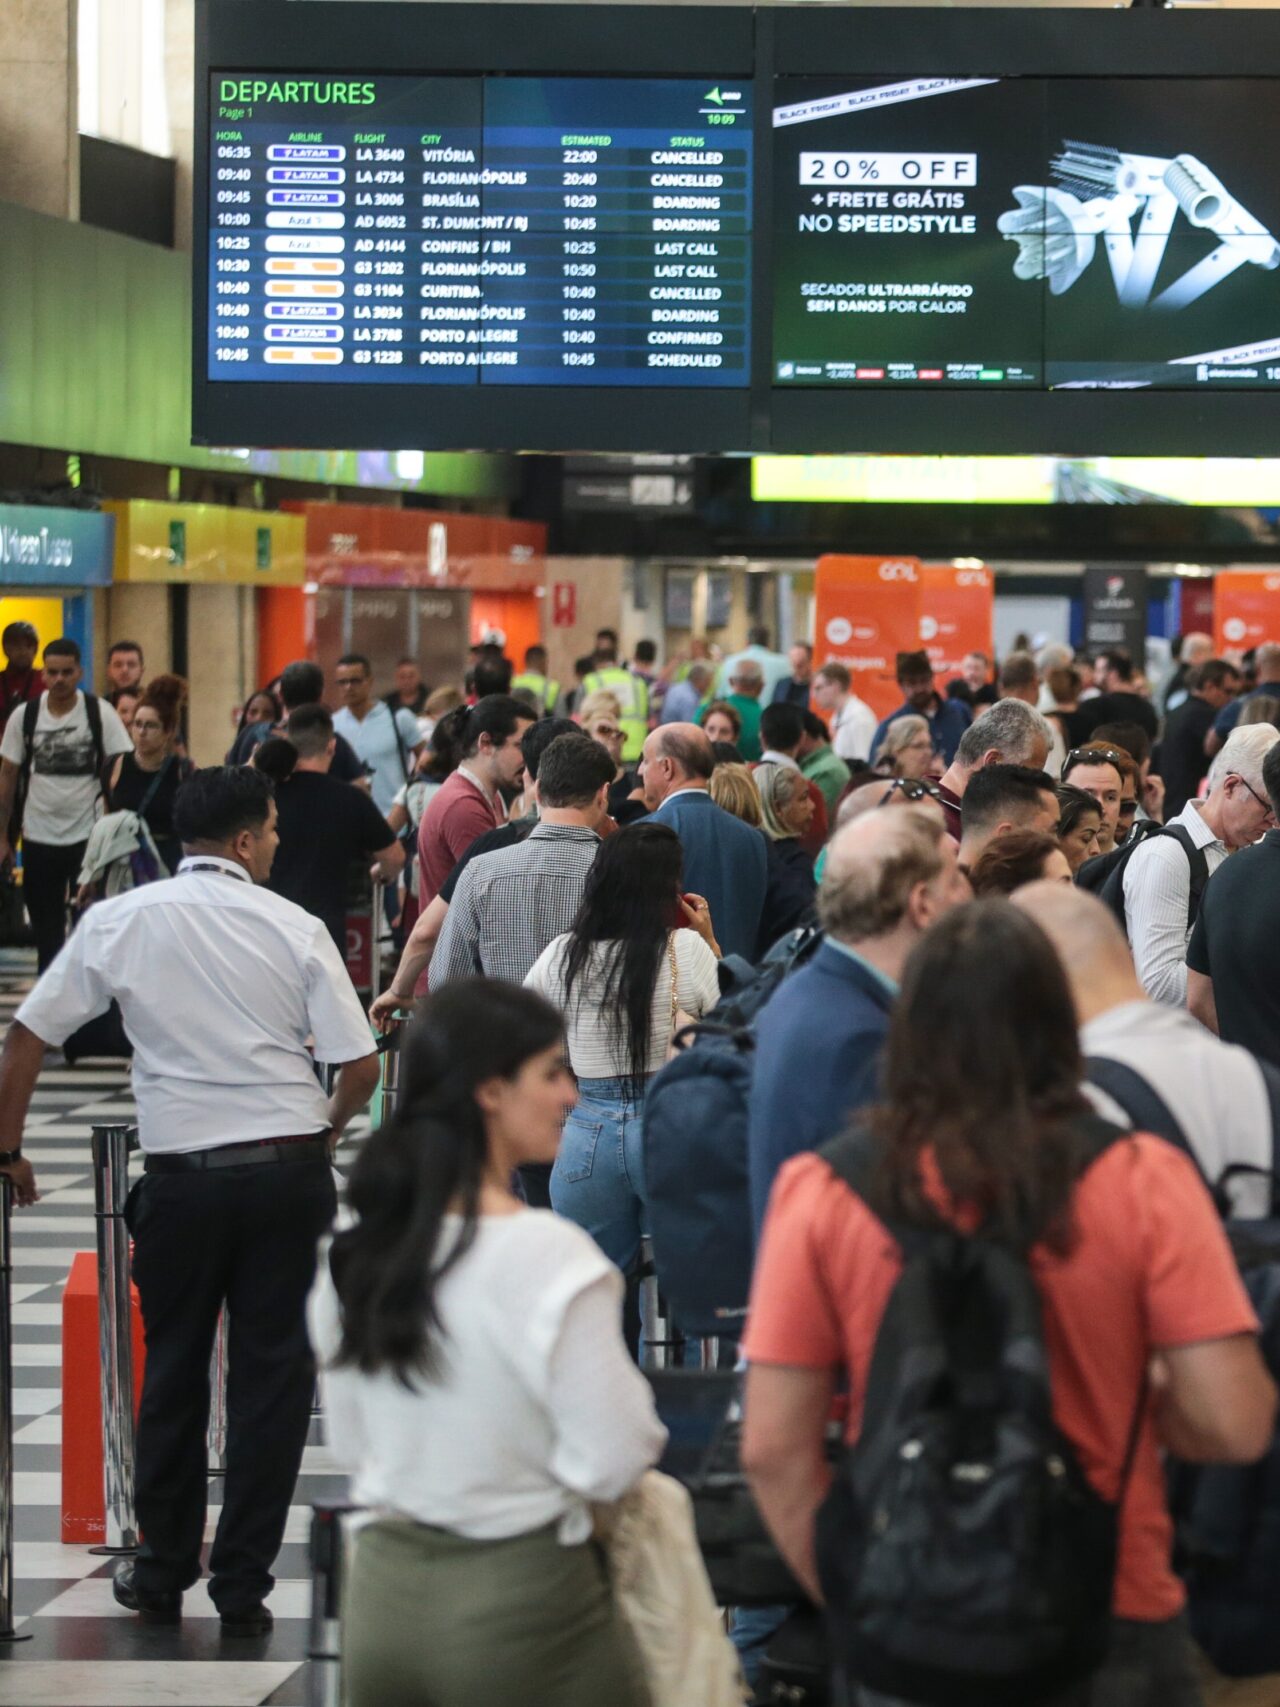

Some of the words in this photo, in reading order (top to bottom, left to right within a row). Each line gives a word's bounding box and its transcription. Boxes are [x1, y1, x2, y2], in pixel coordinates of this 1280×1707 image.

[221, 80, 375, 103] DEPARTURES
[848, 94, 877, 106] BLACK
[880, 87, 910, 98] FRIDAY
[219, 107, 244, 120] Page
[248, 107, 252, 117] 1
[780, 109, 808, 119] BLACK
[811, 102, 841, 112] FRIDAY
[216, 132, 242, 140] HORA
[289, 133, 323, 142] AIRLINE
[355, 134, 386, 143] FLIGHT
[421, 135, 441, 144] CITY
[561, 136, 611, 146] ESTIMATED
[670, 137, 704, 147] STATUS
[218, 146, 251, 158] 06:35
[356, 149, 373, 160] LA
[423, 147, 474, 162] VITÓRIA
[563, 151, 597, 163] 22:00
[651, 152, 723, 164] CANCELLED
[218, 168, 251, 180] 09:40
[811, 160, 879, 179] 20%
[902, 161, 968, 179] OFF
[356, 171, 373, 183] LA
[374, 171, 404, 183] 4734
[423, 169, 527, 184] FLORIANÓPOLIS
[563, 173, 597, 185] 20:40
[651, 174, 723, 187] CANCELLED
[217, 191, 250, 203] 09:45
[356, 193, 372, 205] LA
[423, 192, 479, 207] BRASÍLIA
[564, 195, 597, 207] 10:20
[653, 196, 720, 209] BOARDING
[827, 192, 888, 207] FRETE
[893, 190, 964, 208] GRÁTIS
[218, 213, 250, 225] 10:00
[355, 215, 374, 227] AD
[422, 216, 441, 228] ST.
[564, 218, 596, 230] 10:45
[653, 218, 720, 231] BOARDING
[799, 214, 832, 232] NO
[838, 215, 976, 233] SPEEDSTYLE
[217, 237, 250, 249] 10:25
[355, 239, 374, 251] AD
[375, 240, 405, 252] 4144
[422, 240, 479, 253] CONFINS
[564, 242, 596, 254] 10:25
[655, 243, 685, 255] LAST
[687, 243, 717, 255] CALL
[217, 259, 250, 271] 10:30
[354, 261, 372, 274] G3
[422, 260, 526, 276] FLORIANÓPOLIS
[564, 264, 596, 276] 10:50
[655, 265, 685, 277] LAST
[686, 266, 717, 277] CALL
[217, 282, 249, 294] 10:40
[354, 284, 372, 296] G3
[563, 286, 595, 298] 10:40
[650, 287, 721, 300] CANCELLED
[801, 283, 865, 295] SECADOR
[868, 282, 973, 297] ULTRARRÁPIDO
[216, 304, 249, 316] 10:40
[354, 306, 371, 318] LA
[421, 305, 525, 320] FLORIANÓPOLIS
[807, 300, 834, 311] SEM
[837, 301, 886, 312] DANOS
[889, 301, 917, 312] POR
[919, 301, 966, 313] CALOR
[563, 309, 595, 320] 10:40
[652, 309, 719, 322] BOARDING
[216, 326, 249, 338] 10:40
[354, 328, 371, 340] LA
[421, 329, 465, 342] PORTO
[466, 330, 517, 342] ALEGRE
[563, 331, 595, 343] 10:40
[648, 332, 722, 344] CONFIRMED
[216, 348, 249, 361] 10:45
[420, 352, 465, 364] PORTO
[466, 352, 517, 365] ALEGRE
[563, 353, 595, 365] 10:45
[648, 354, 722, 367] SCHEDULED
